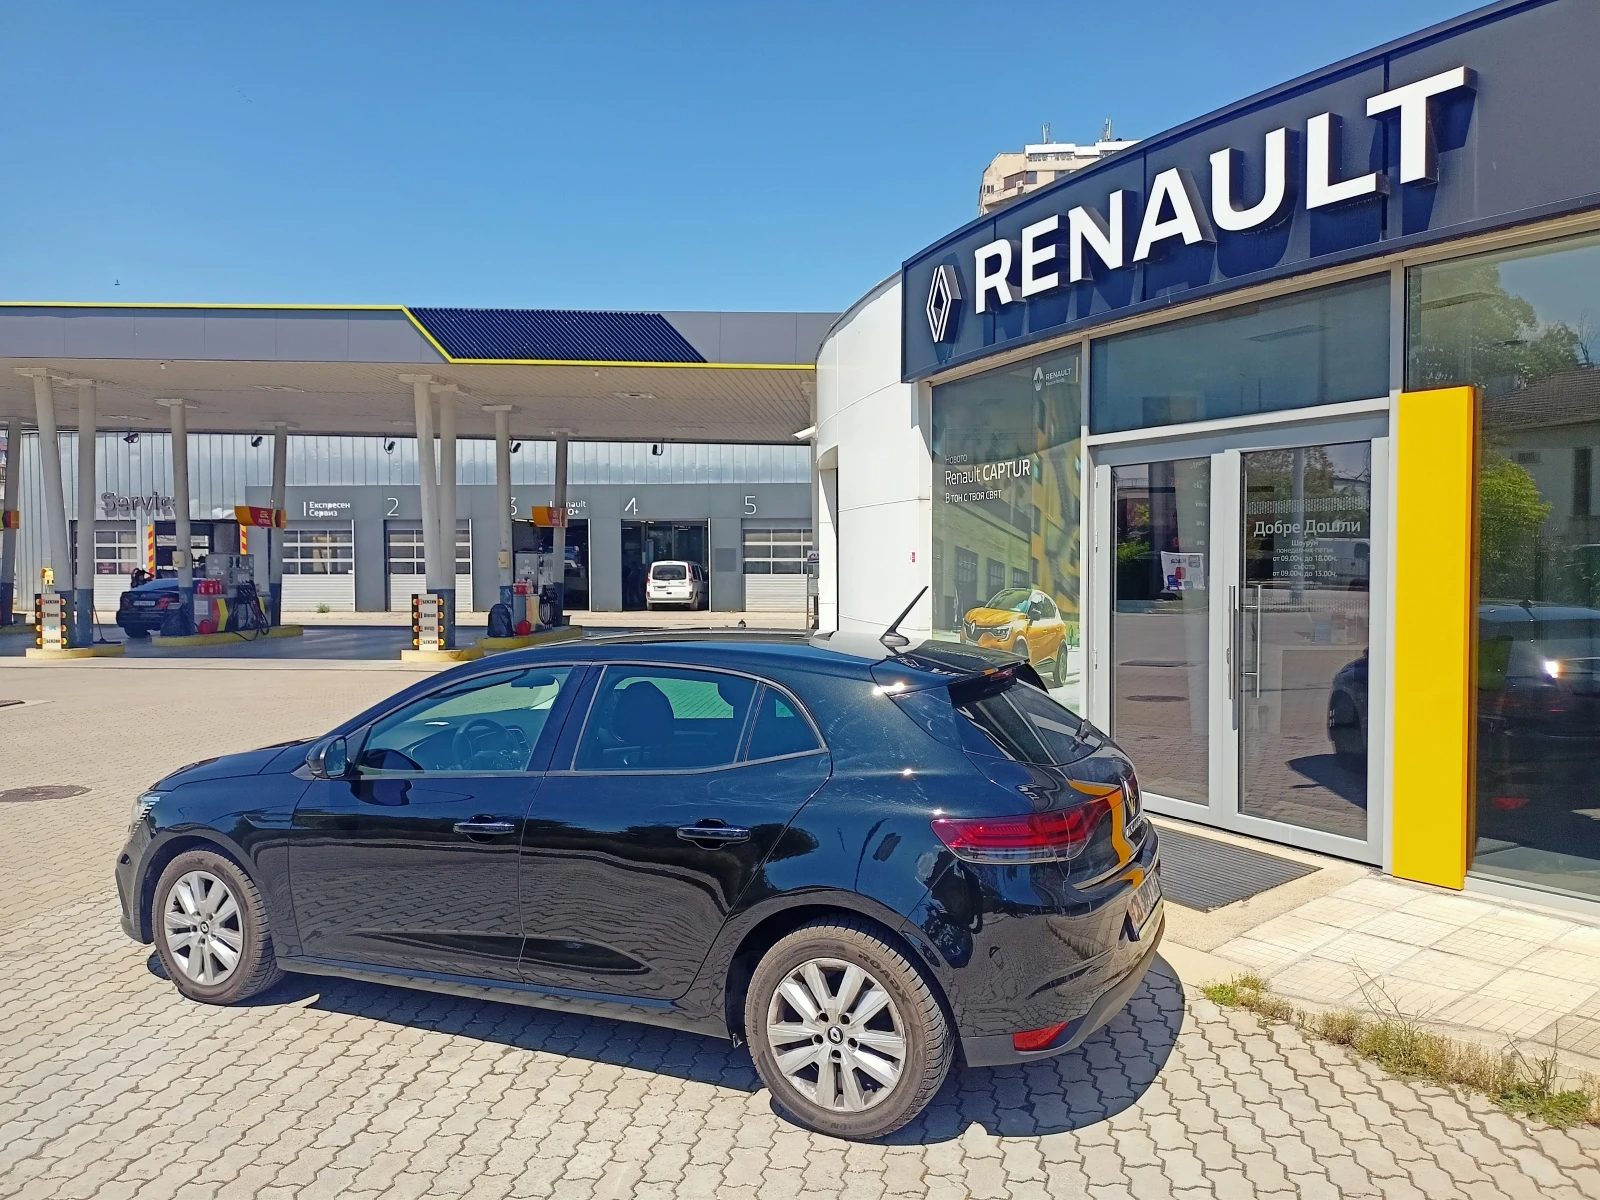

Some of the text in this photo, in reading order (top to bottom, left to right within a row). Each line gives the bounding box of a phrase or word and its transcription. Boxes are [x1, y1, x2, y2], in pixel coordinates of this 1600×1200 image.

[974, 66, 1466, 314] RENAULT
[1046, 368, 1072, 380] RENAULT
[944, 454, 968, 464] Новото
[945, 459, 1030, 486] Renault CAPTUR
[309, 501, 350, 510] Експресен
[309, 509, 338, 518] Сервиз
[386, 497, 398, 516] 2
[624, 497, 638, 516] 4
[744, 495, 757, 515] 5
[1254, 520, 1360, 537] Добре Дошли
[1292, 540, 1318, 548] Шоурум
[858, 950, 911, 1005] ROADX
